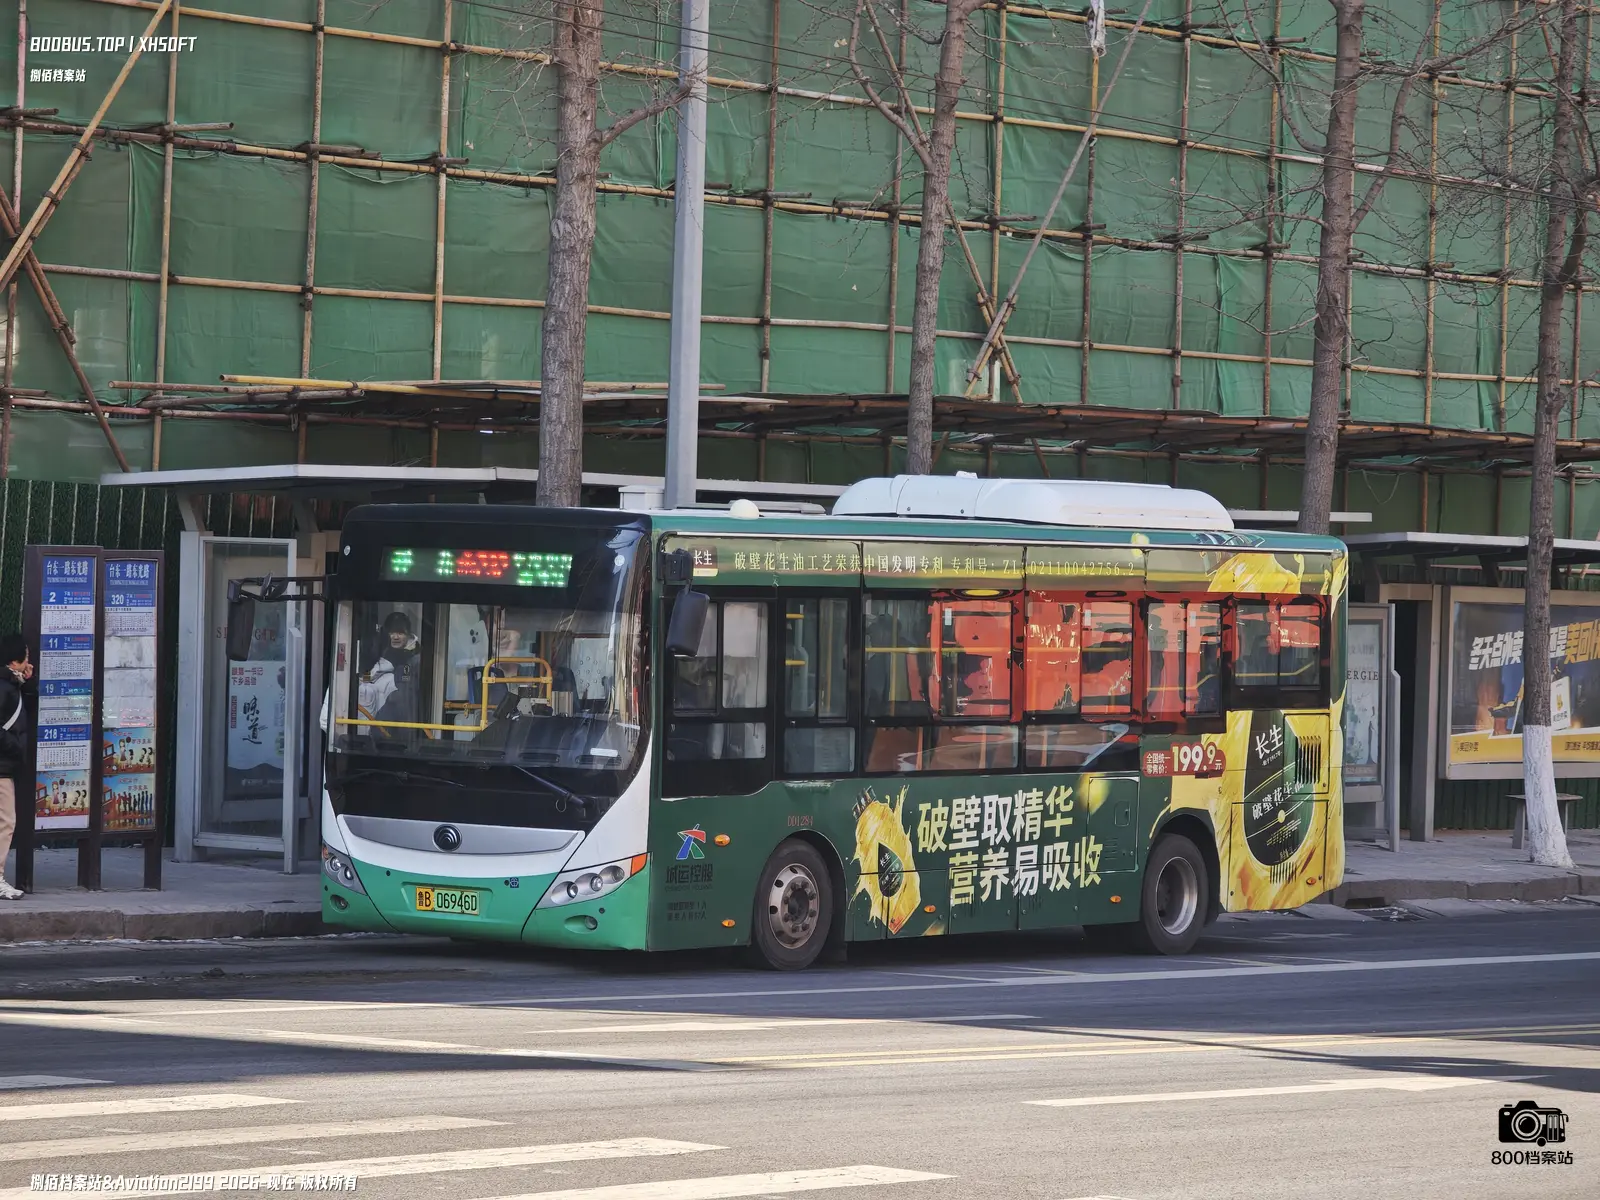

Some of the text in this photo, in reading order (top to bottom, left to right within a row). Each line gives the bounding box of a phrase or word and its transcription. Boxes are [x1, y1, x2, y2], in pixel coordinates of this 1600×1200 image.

[693, 550, 713, 566] 长生
[734, 551, 943, 574] 破壁花生油工艺荣获中国发明专利
[49, 592, 56, 603] 2
[111, 594, 125, 605] 320
[48, 637, 58, 649] 11
[45, 683, 54, 694] 19
[44, 728, 58, 740] 218
[1255, 724, 1284, 760] 长生
[1146, 753, 1171, 764] 全国统一
[917, 785, 1074, 853] 破壁取精华
[665, 863, 714, 885] 城运控股
[949, 835, 1104, 907] 营养易吸收
